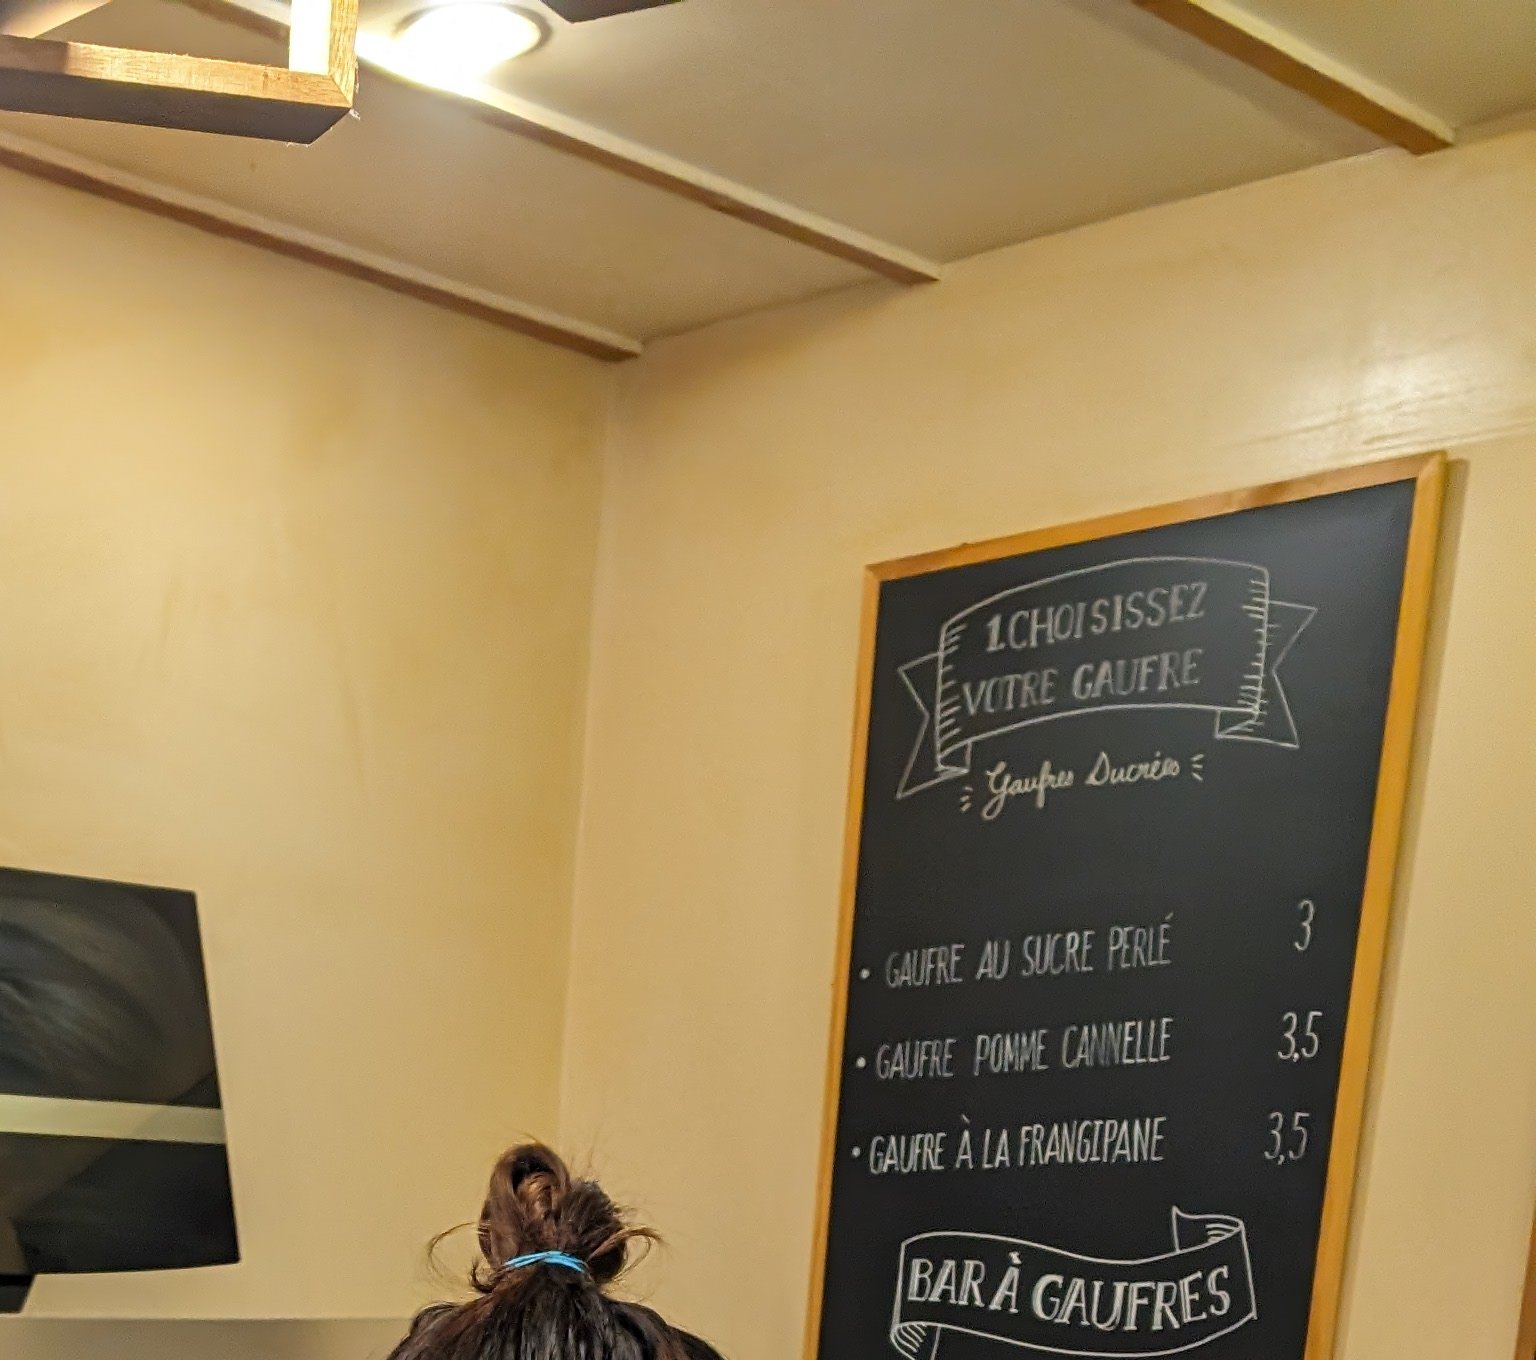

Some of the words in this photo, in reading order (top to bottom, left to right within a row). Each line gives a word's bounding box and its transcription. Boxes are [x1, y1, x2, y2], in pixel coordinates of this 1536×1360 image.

[962, 668, 1059, 717] VOTRE
[1072, 648, 1203, 700] GAUFRE
[885, 943, 965, 988] GAUFRE
[975, 939, 1011, 980] AU
[1021, 929, 1095, 977] SUCRE
[1108, 911, 1174, 971] PERLÉ
[1294, 899, 1317, 953] 3
[875, 1037, 957, 1081] GAUFRE
[972, 1028, 1050, 1077] POMME
[1062, 1016, 1174, 1069] CANNELLE
[869, 1132, 946, 1176] GAUFRE
[955, 1114, 975, 1168] À
[982, 1128, 1010, 1169] LA
[1019, 1116, 1167, 1166] FRANGIPANE
[907, 1257, 986, 1305] BAR
[989, 1251, 1021, 1314] À
[1032, 1265, 1231, 1332] GAUFRES
